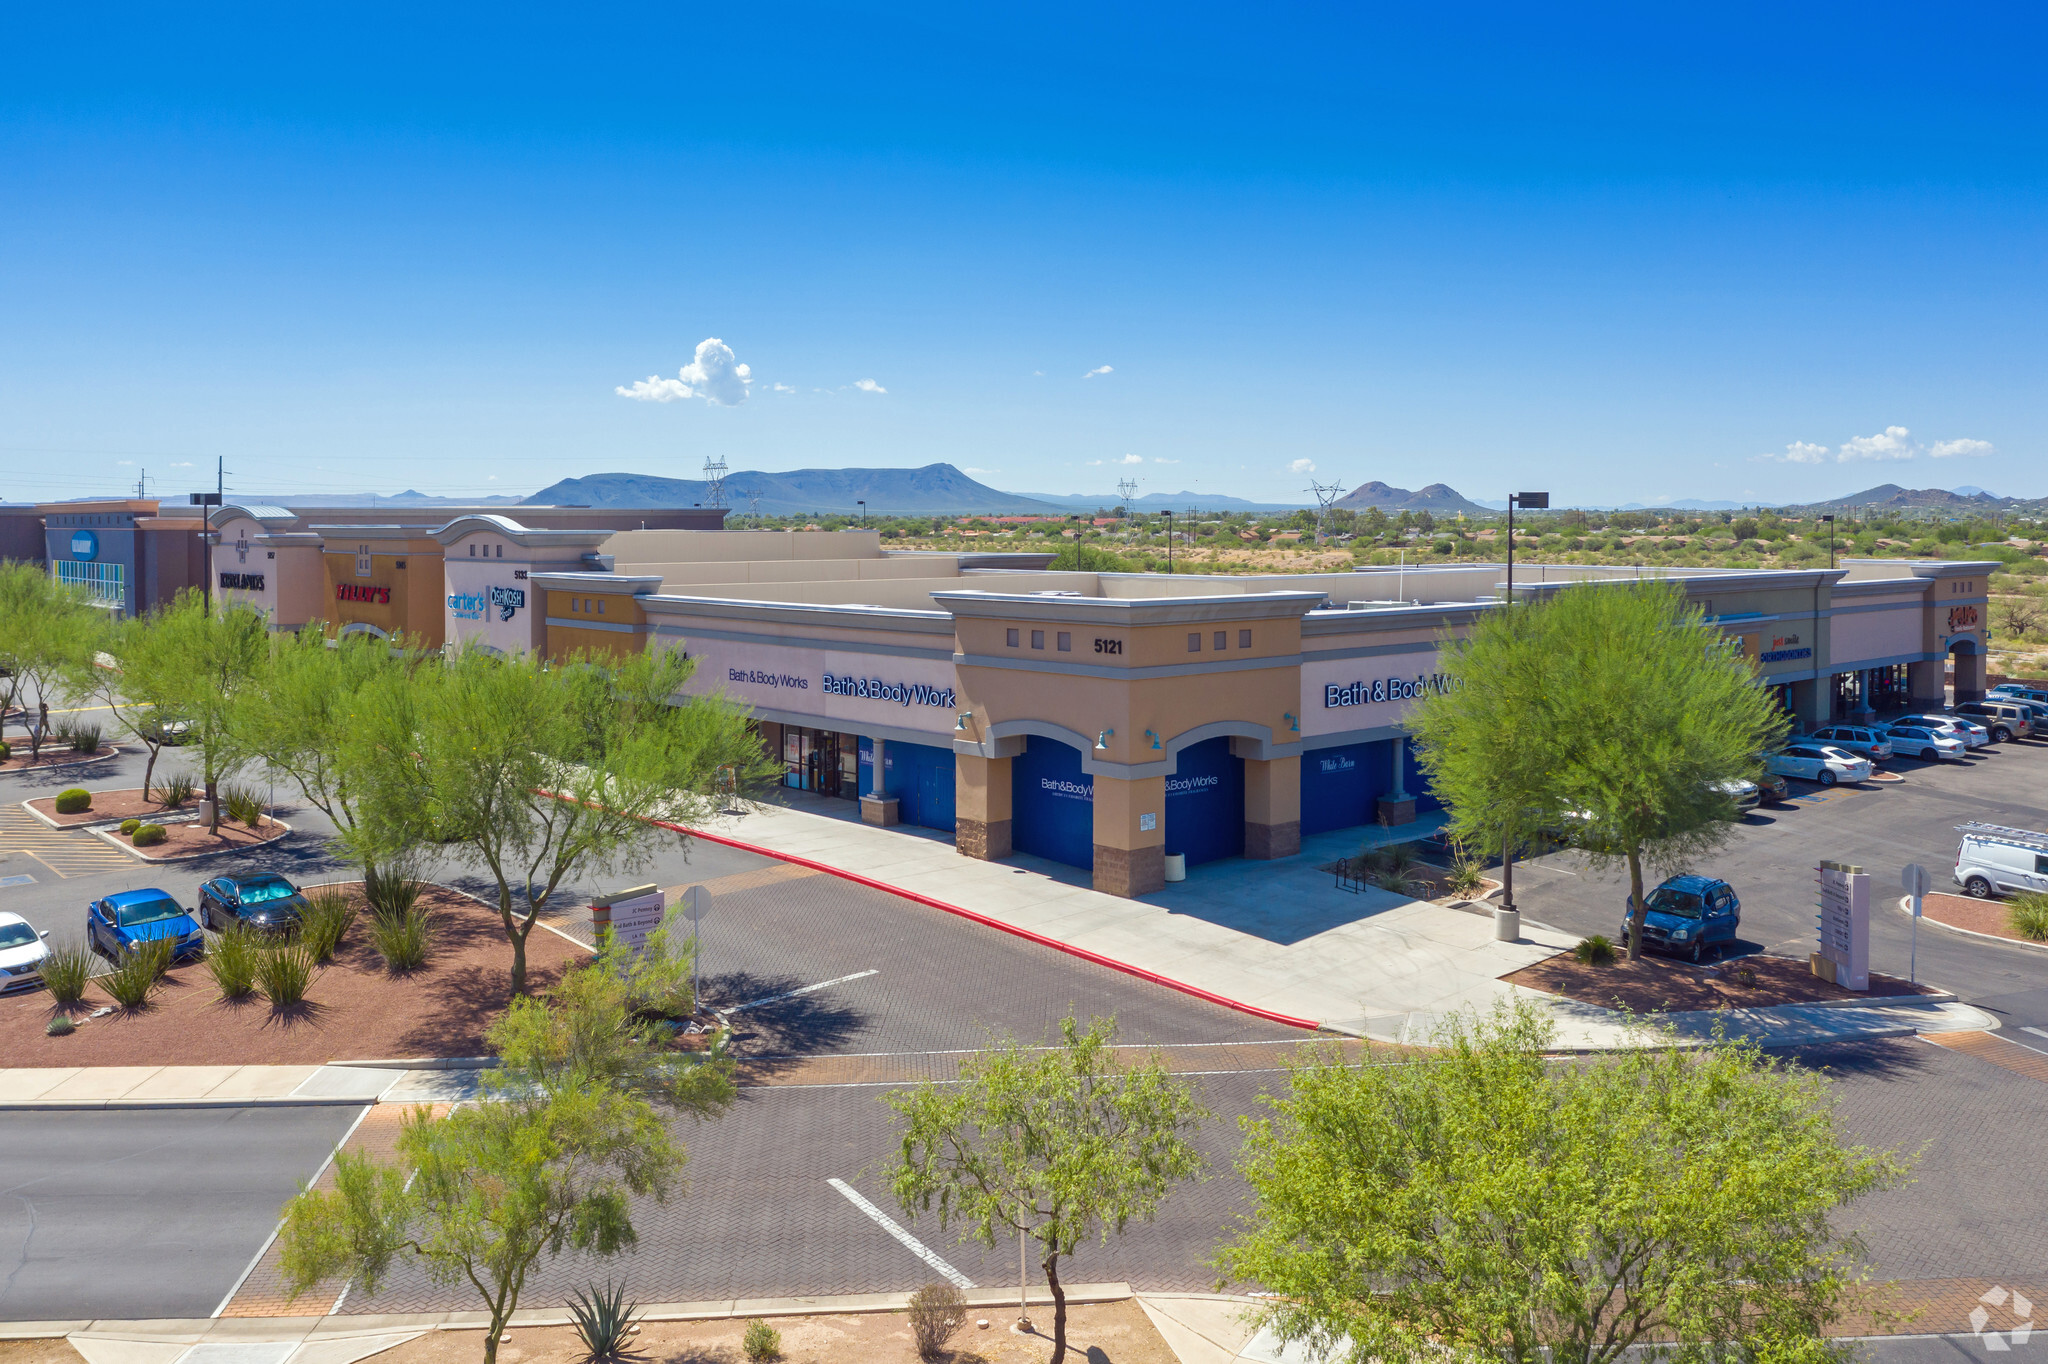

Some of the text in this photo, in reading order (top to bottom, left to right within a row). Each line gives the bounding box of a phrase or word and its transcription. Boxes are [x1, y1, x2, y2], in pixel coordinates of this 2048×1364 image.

[447, 592, 485, 611] carter's
[1094, 638, 1122, 655] 5121
[1771, 635, 1784, 651] just
[729, 668, 748, 682] Bath
[757, 671, 779, 688] Body
[778, 674, 808, 689] Works
[822, 674, 857, 697] Bath
[870, 680, 913, 707] Body
[912, 684, 956, 709] Work
[1325, 681, 1370, 708] Bath
[1371, 680, 1386, 702] &
[1387, 675, 1434, 701] Body
[1320, 758, 1337, 772] White
[1192, 775, 1218, 788] Works
